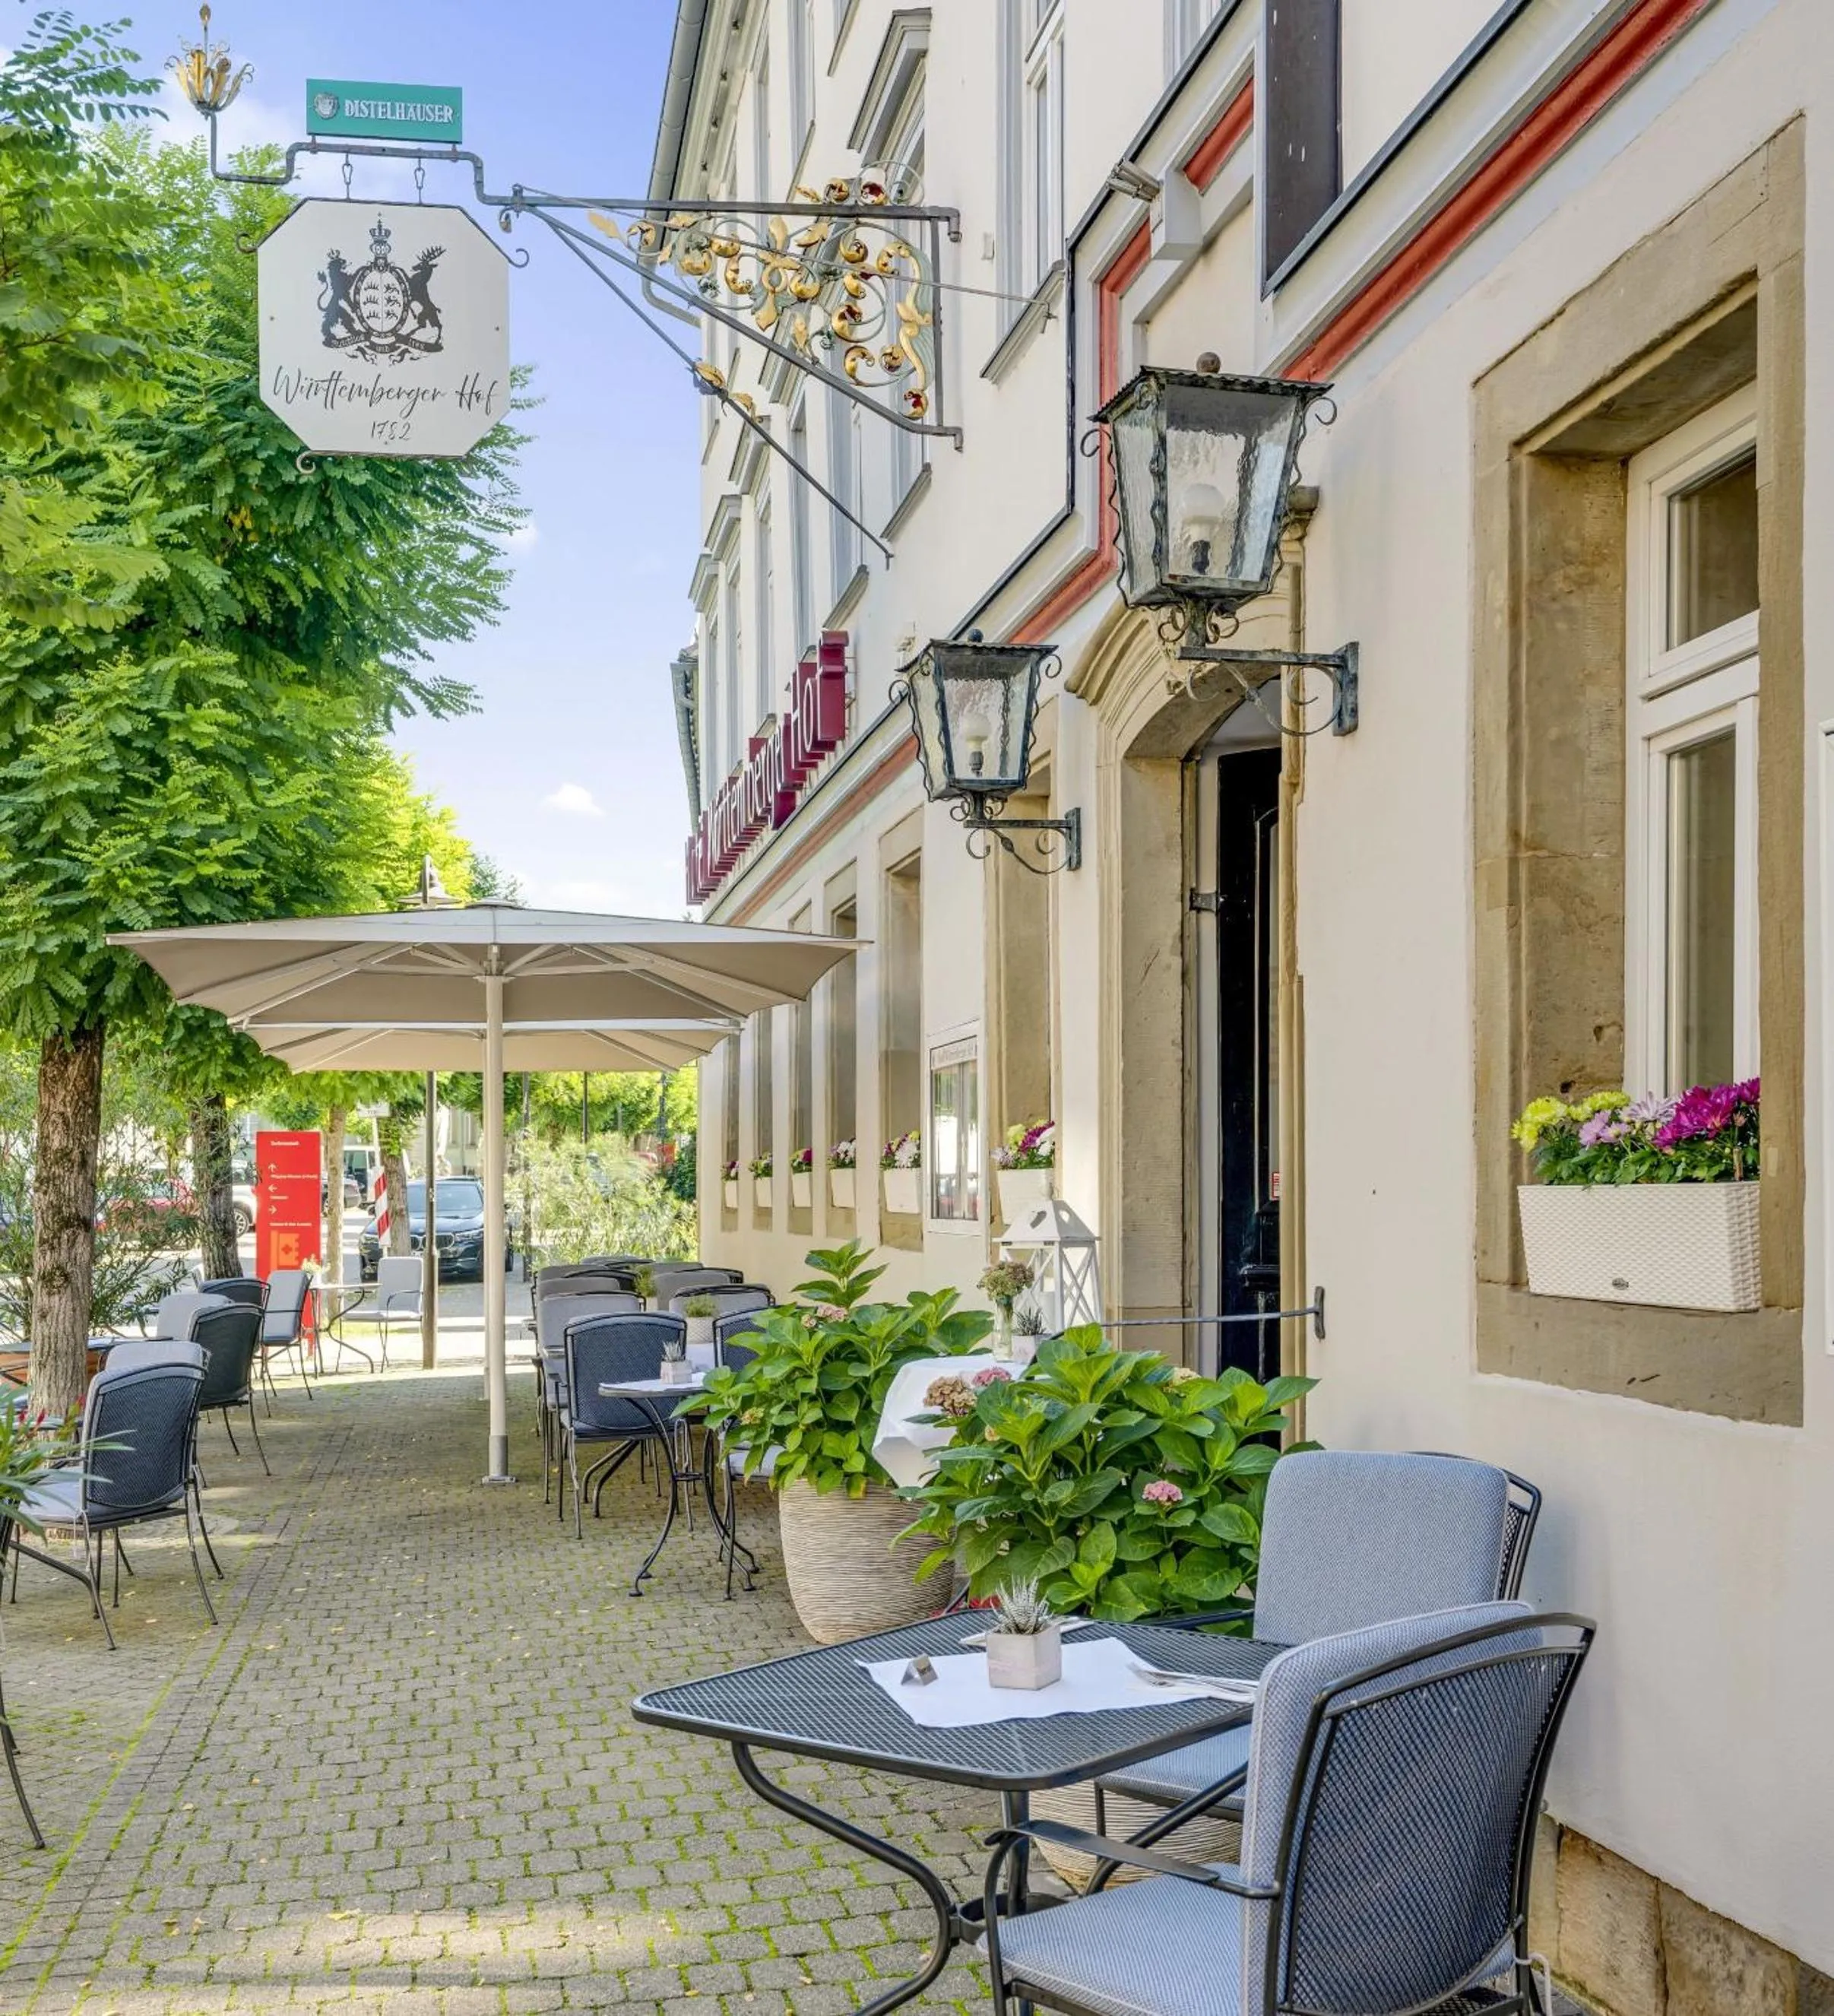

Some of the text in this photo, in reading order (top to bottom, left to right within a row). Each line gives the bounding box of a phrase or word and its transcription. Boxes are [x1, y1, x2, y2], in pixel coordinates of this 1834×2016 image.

[344, 100, 454, 124] DISTELHÄUSER
[273, 365, 499, 419] Württemberger Hof
[791, 630, 849, 770] Hof
